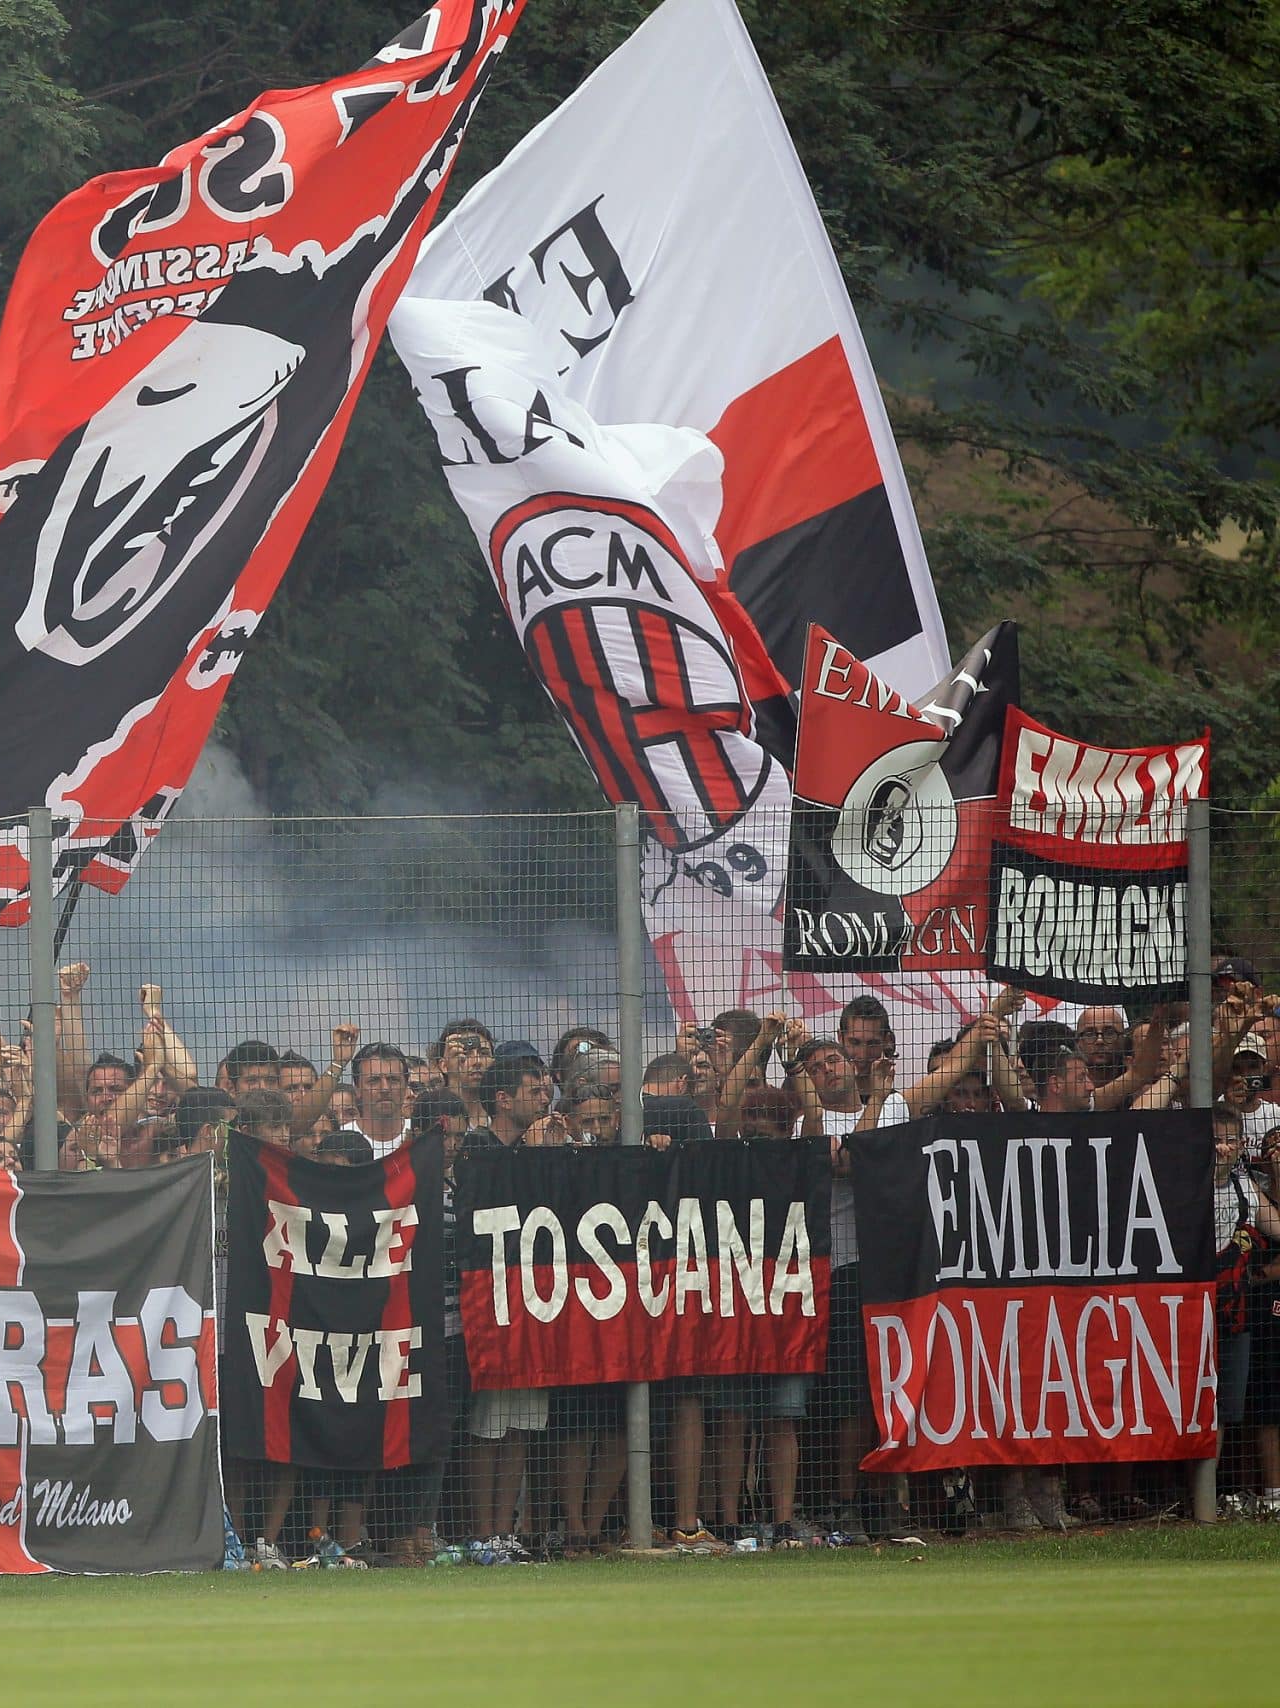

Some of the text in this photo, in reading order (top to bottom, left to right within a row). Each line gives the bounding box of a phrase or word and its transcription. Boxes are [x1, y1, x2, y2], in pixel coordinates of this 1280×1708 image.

[515, 526, 669, 620] ACM
[793, 904, 990, 958] ROMAGN
[994, 867, 1188, 988] ROMAGN
[262, 1200, 420, 1279] ALE
[923, 1133, 1183, 1282] EMILIA
[473, 1198, 816, 1326] TOSCANA
[245, 1312, 423, 1404] VIVE
[871, 1291, 1217, 1450] ROMAGNA
[32, 1478, 133, 1529] Milano
